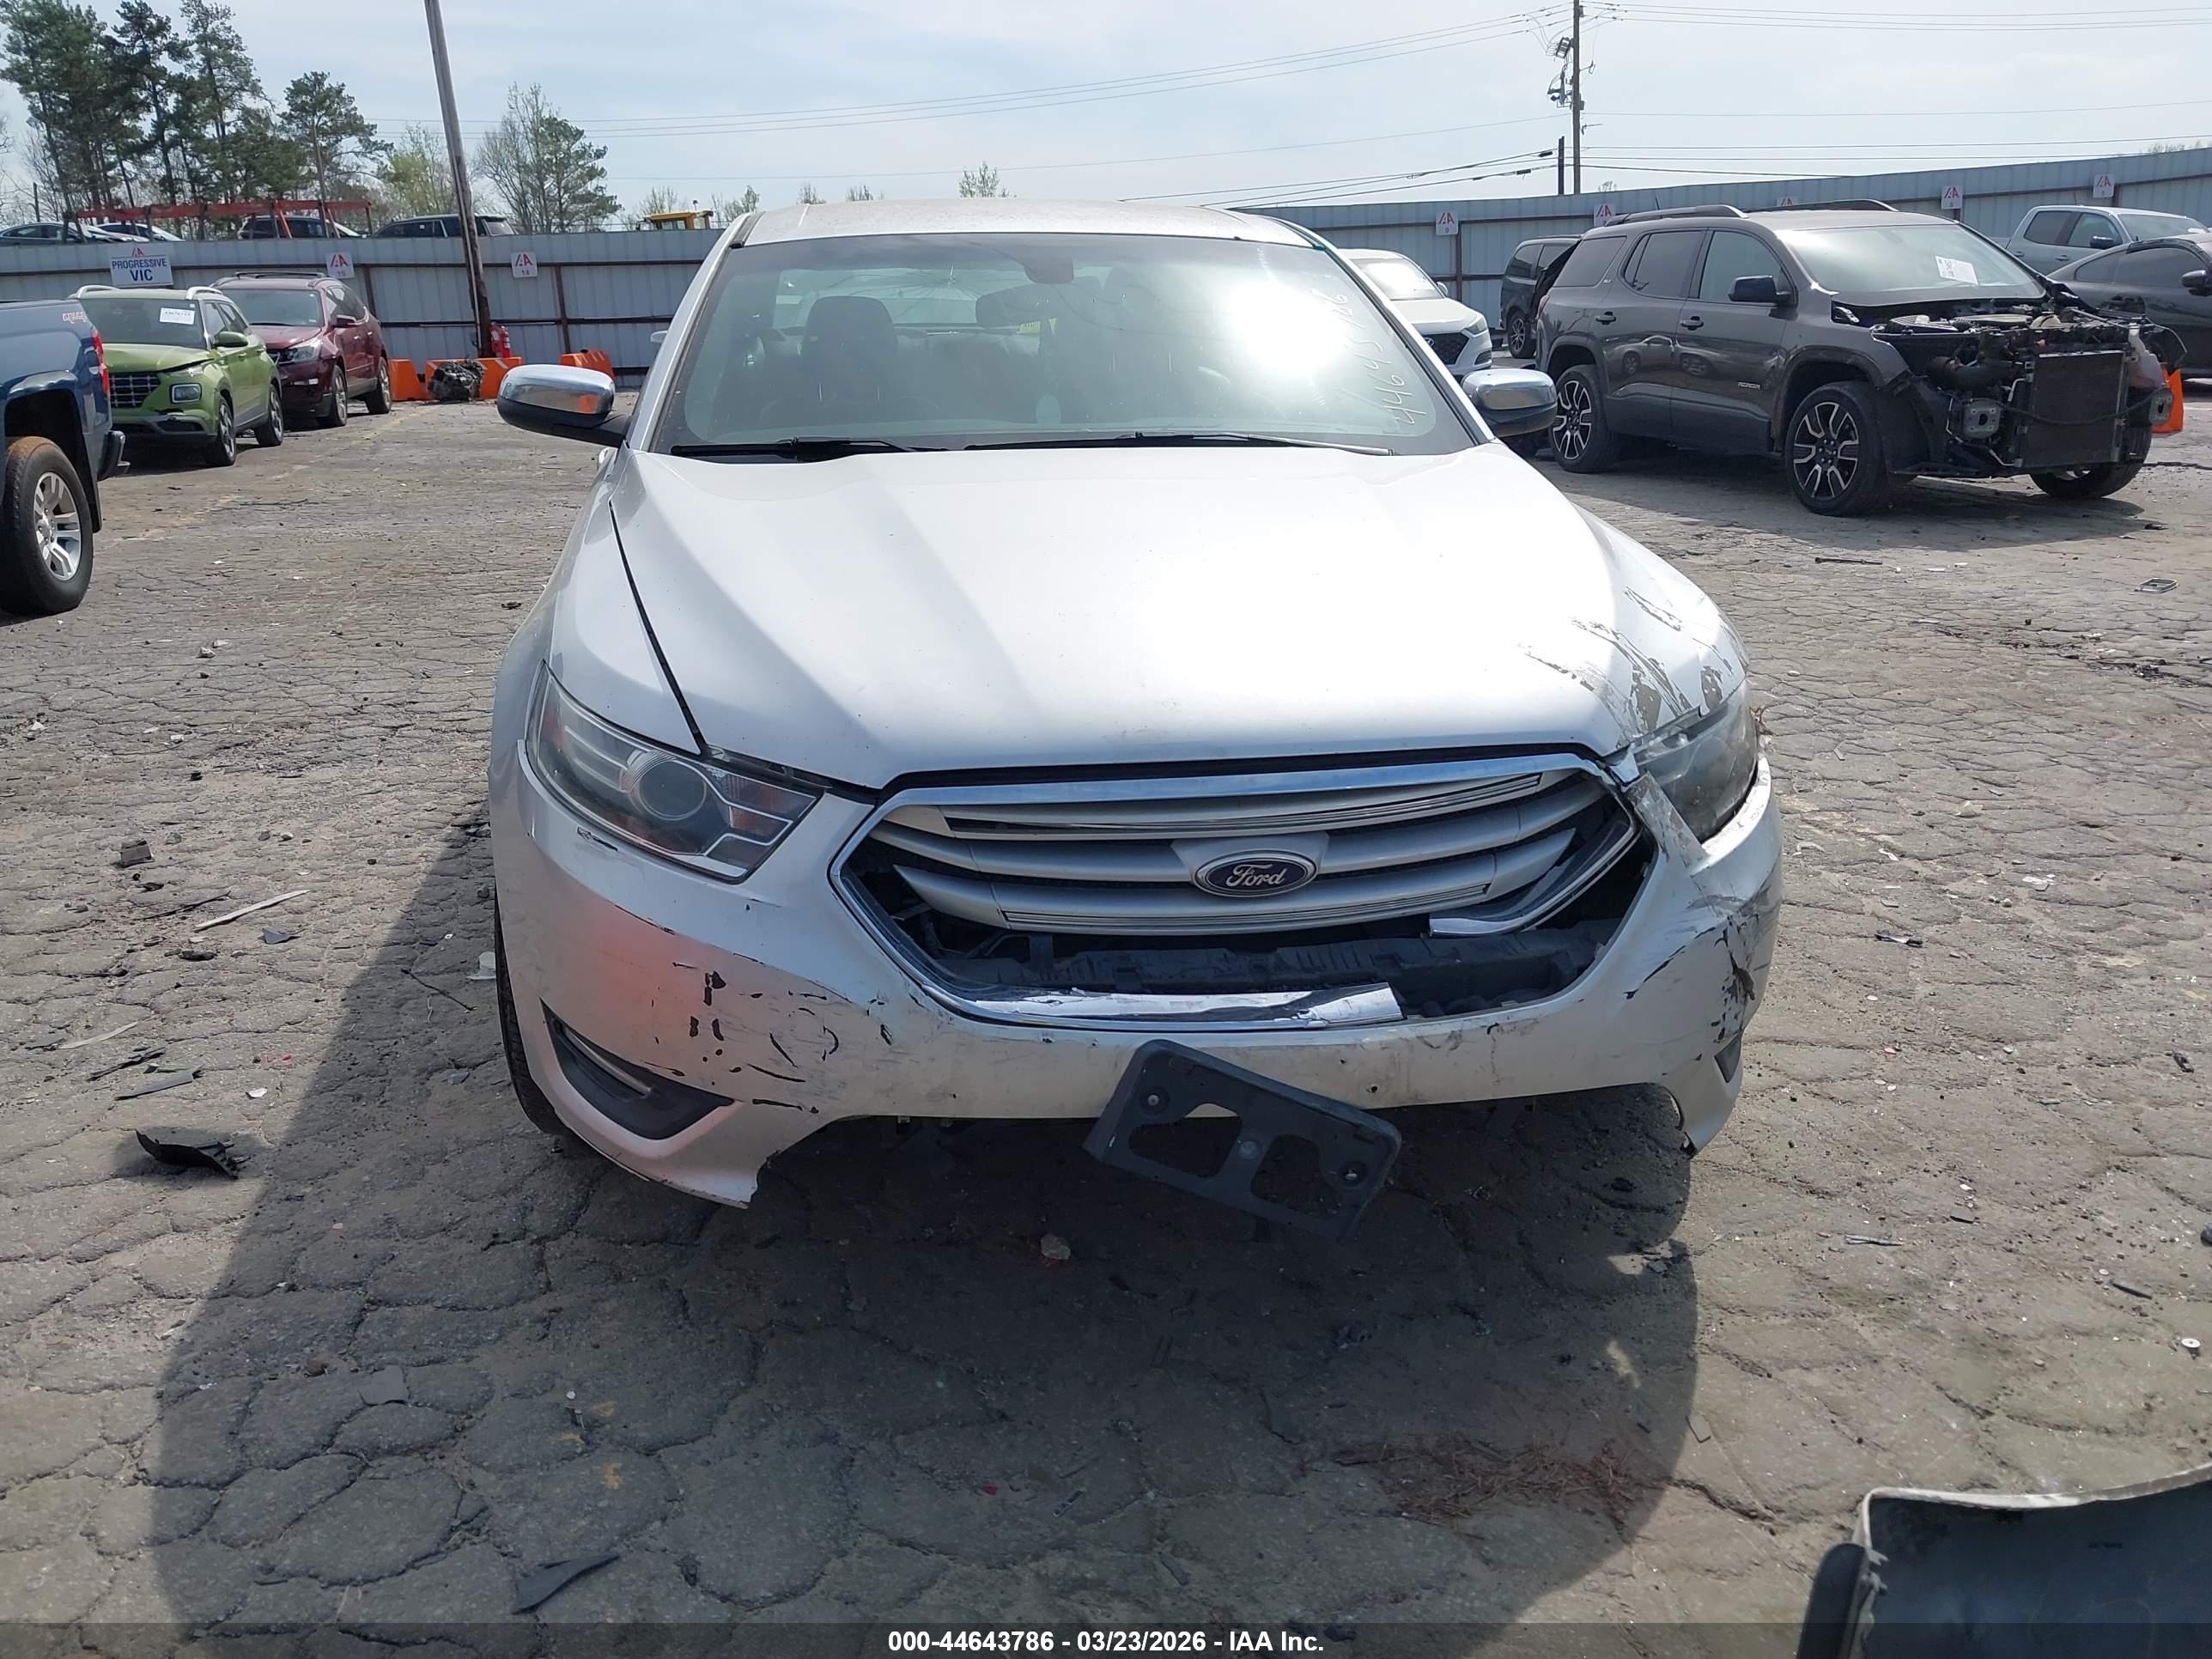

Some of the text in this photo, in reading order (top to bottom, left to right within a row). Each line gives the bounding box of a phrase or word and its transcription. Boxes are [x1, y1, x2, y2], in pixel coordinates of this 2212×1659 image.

[112, 258, 167, 269] PROGRESSIVE
[130, 269, 153, 281] VIC
[1225, 864, 1286, 887] Ford
